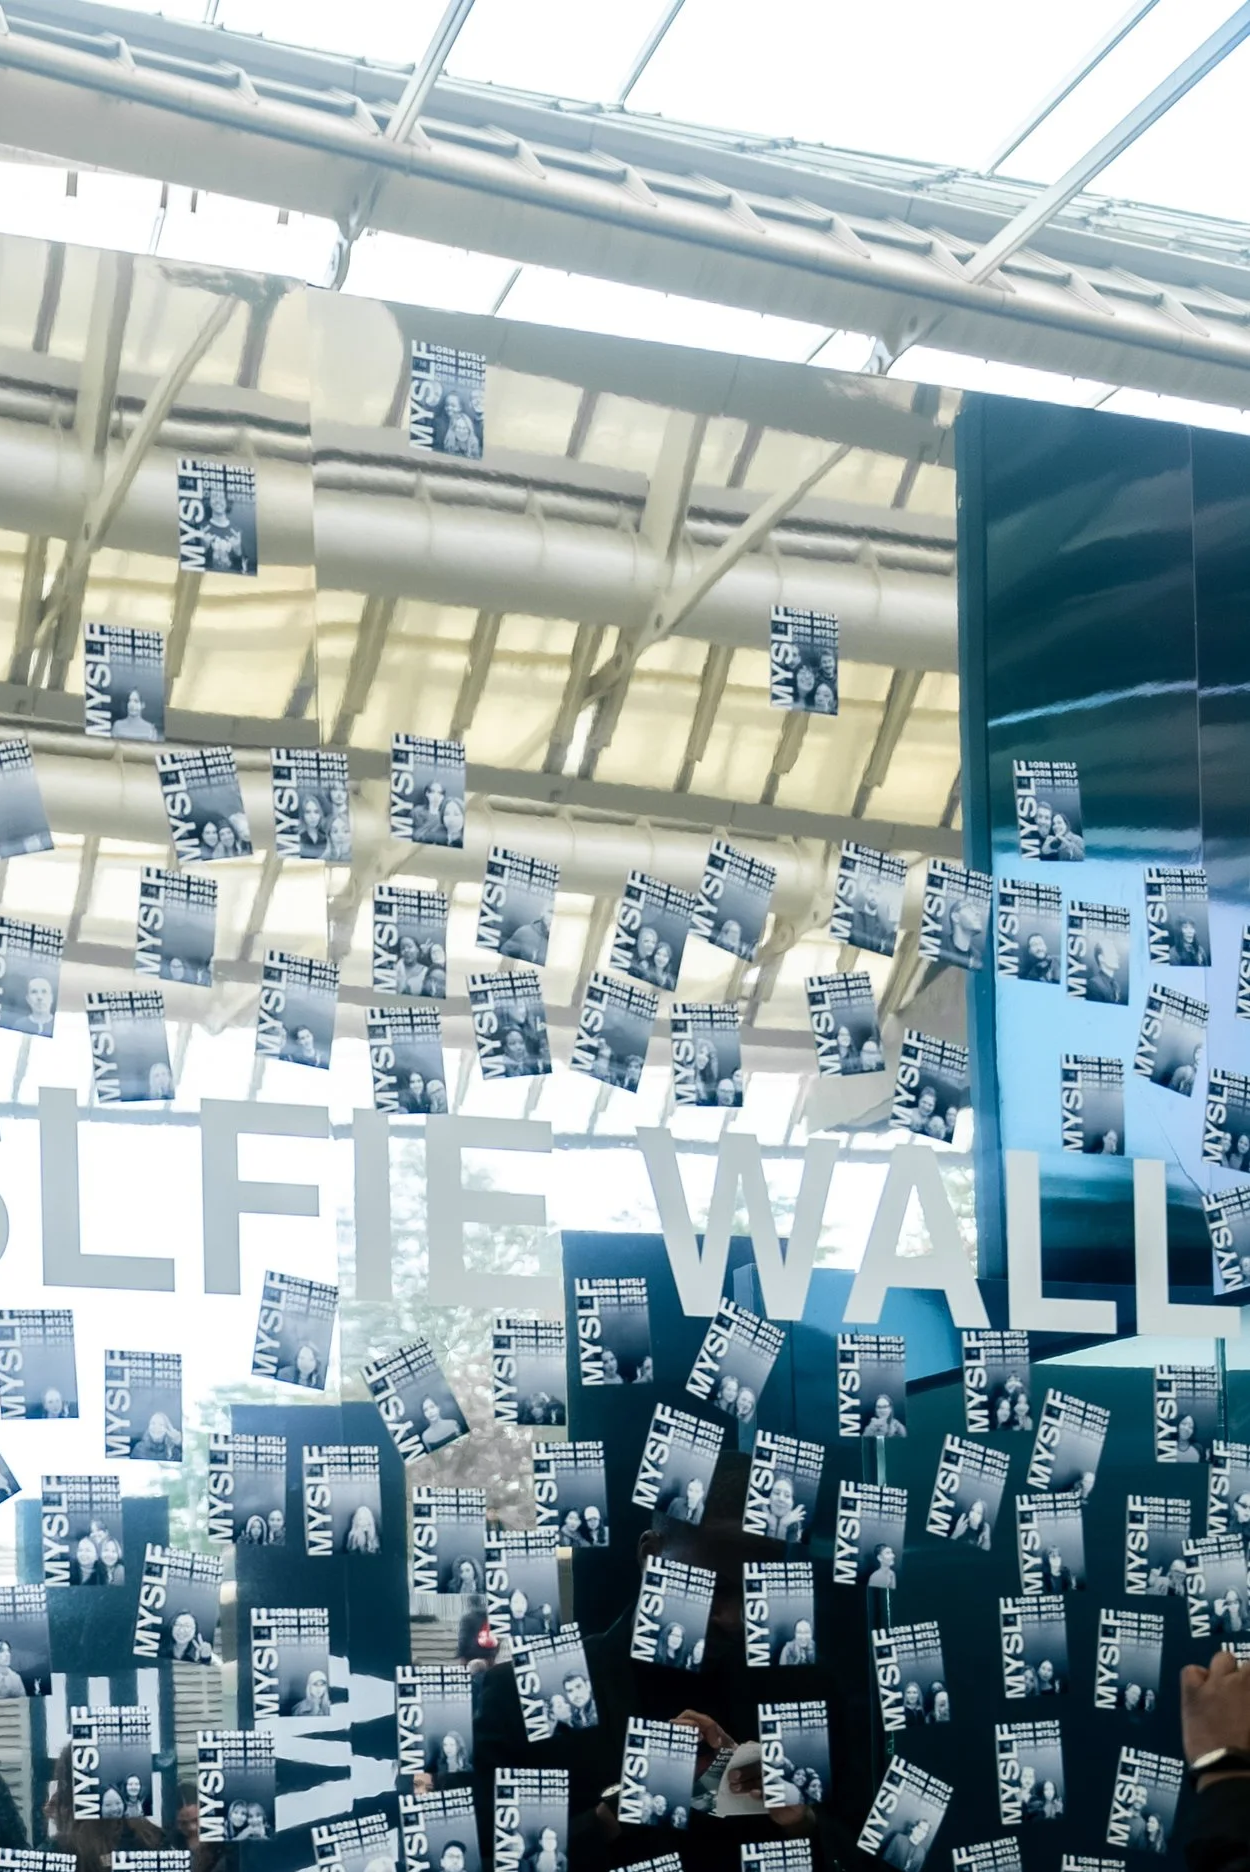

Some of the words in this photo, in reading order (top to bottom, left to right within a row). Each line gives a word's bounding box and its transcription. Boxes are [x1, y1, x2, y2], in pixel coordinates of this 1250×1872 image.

[410, 340, 435, 452] MYSLF
[177, 458, 206, 572] MYSLF
[84, 622, 112, 737] MYSLF
[771, 604, 793, 710] MYSLF
[155, 752, 204, 866] MYSLF
[271, 748, 301, 860] MYSLF
[389, 732, 414, 843] MYSLF
[1013, 761, 1041, 862] MYSLF
[135, 865, 166, 980] MYSLF
[374, 884, 397, 995] MYSLF
[475, 844, 512, 954] MYSLF
[607, 868, 650, 976] MYSLF
[688, 838, 734, 944] MYSLF
[828, 840, 863, 945] MYSLF
[918, 858, 950, 962] MYSLF
[999, 877, 1019, 980] MYSLF
[1144, 868, 1171, 967] MYSLF
[1067, 900, 1087, 1001] MYSLF
[365, 1008, 401, 1117] MYSLF
[466, 973, 507, 1082] MYSLF
[569, 970, 612, 1078] MYSLF
[669, 1003, 697, 1108] MYSLF
[805, 975, 843, 1079] MYSLF
[890, 1028, 925, 1132] MYSLF
[1062, 1053, 1083, 1154] MYSLF
[636, 1125, 1240, 1337] WALL
[1202, 1192, 1245, 1292] MYSLF
[492, 1318, 518, 1426] MYSLF
[575, 1279, 604, 1385] MYSLF
[687, 1297, 743, 1401] MYSLF
[963, 1331, 990, 1432] MYSLF
[361, 1358, 428, 1466] MYSLF
[838, 1334, 861, 1437] MYSLF
[1156, 1364, 1178, 1462] MYSLF
[209, 1433, 233, 1544] MYSLF
[633, 1403, 679, 1510] MYSLF
[744, 1430, 779, 1536] MYSLF
[928, 1434, 967, 1537] MYSLF
[1028, 1388, 1069, 1490] MYSLF
[304, 1446, 334, 1555] MYSLF
[413, 1487, 438, 1595] MYSLF
[835, 1481, 862, 1585] MYSLF
[1016, 1495, 1045, 1595] MYSLF
[1127, 1495, 1148, 1595] MYSLF
[133, 1544, 171, 1658] MYSLF
[482, 1531, 511, 1638] MYSLF
[632, 1555, 670, 1663] MYSLF
[744, 1563, 770, 1666] MYSLF
[1181, 1539, 1211, 1638] MYSLF
[252, 1609, 280, 1718] MYSLF
[873, 1628, 907, 1731] MYSLF
[1000, 1598, 1026, 1698] MYSLF
[1097, 1609, 1121, 1709] MYSLF
[72, 1707, 100, 1819] MYSLF
[397, 1666, 425, 1774] MYSLF
[620, 1717, 652, 1824] MYSLF
[758, 1704, 786, 1808] MYSLF
[197, 1731, 225, 1842] MYSLF
[857, 1754, 913, 1856] MYSLF
[996, 1724, 1022, 1825] MYSLF
[1108, 1746, 1142, 1847] MYSLF
